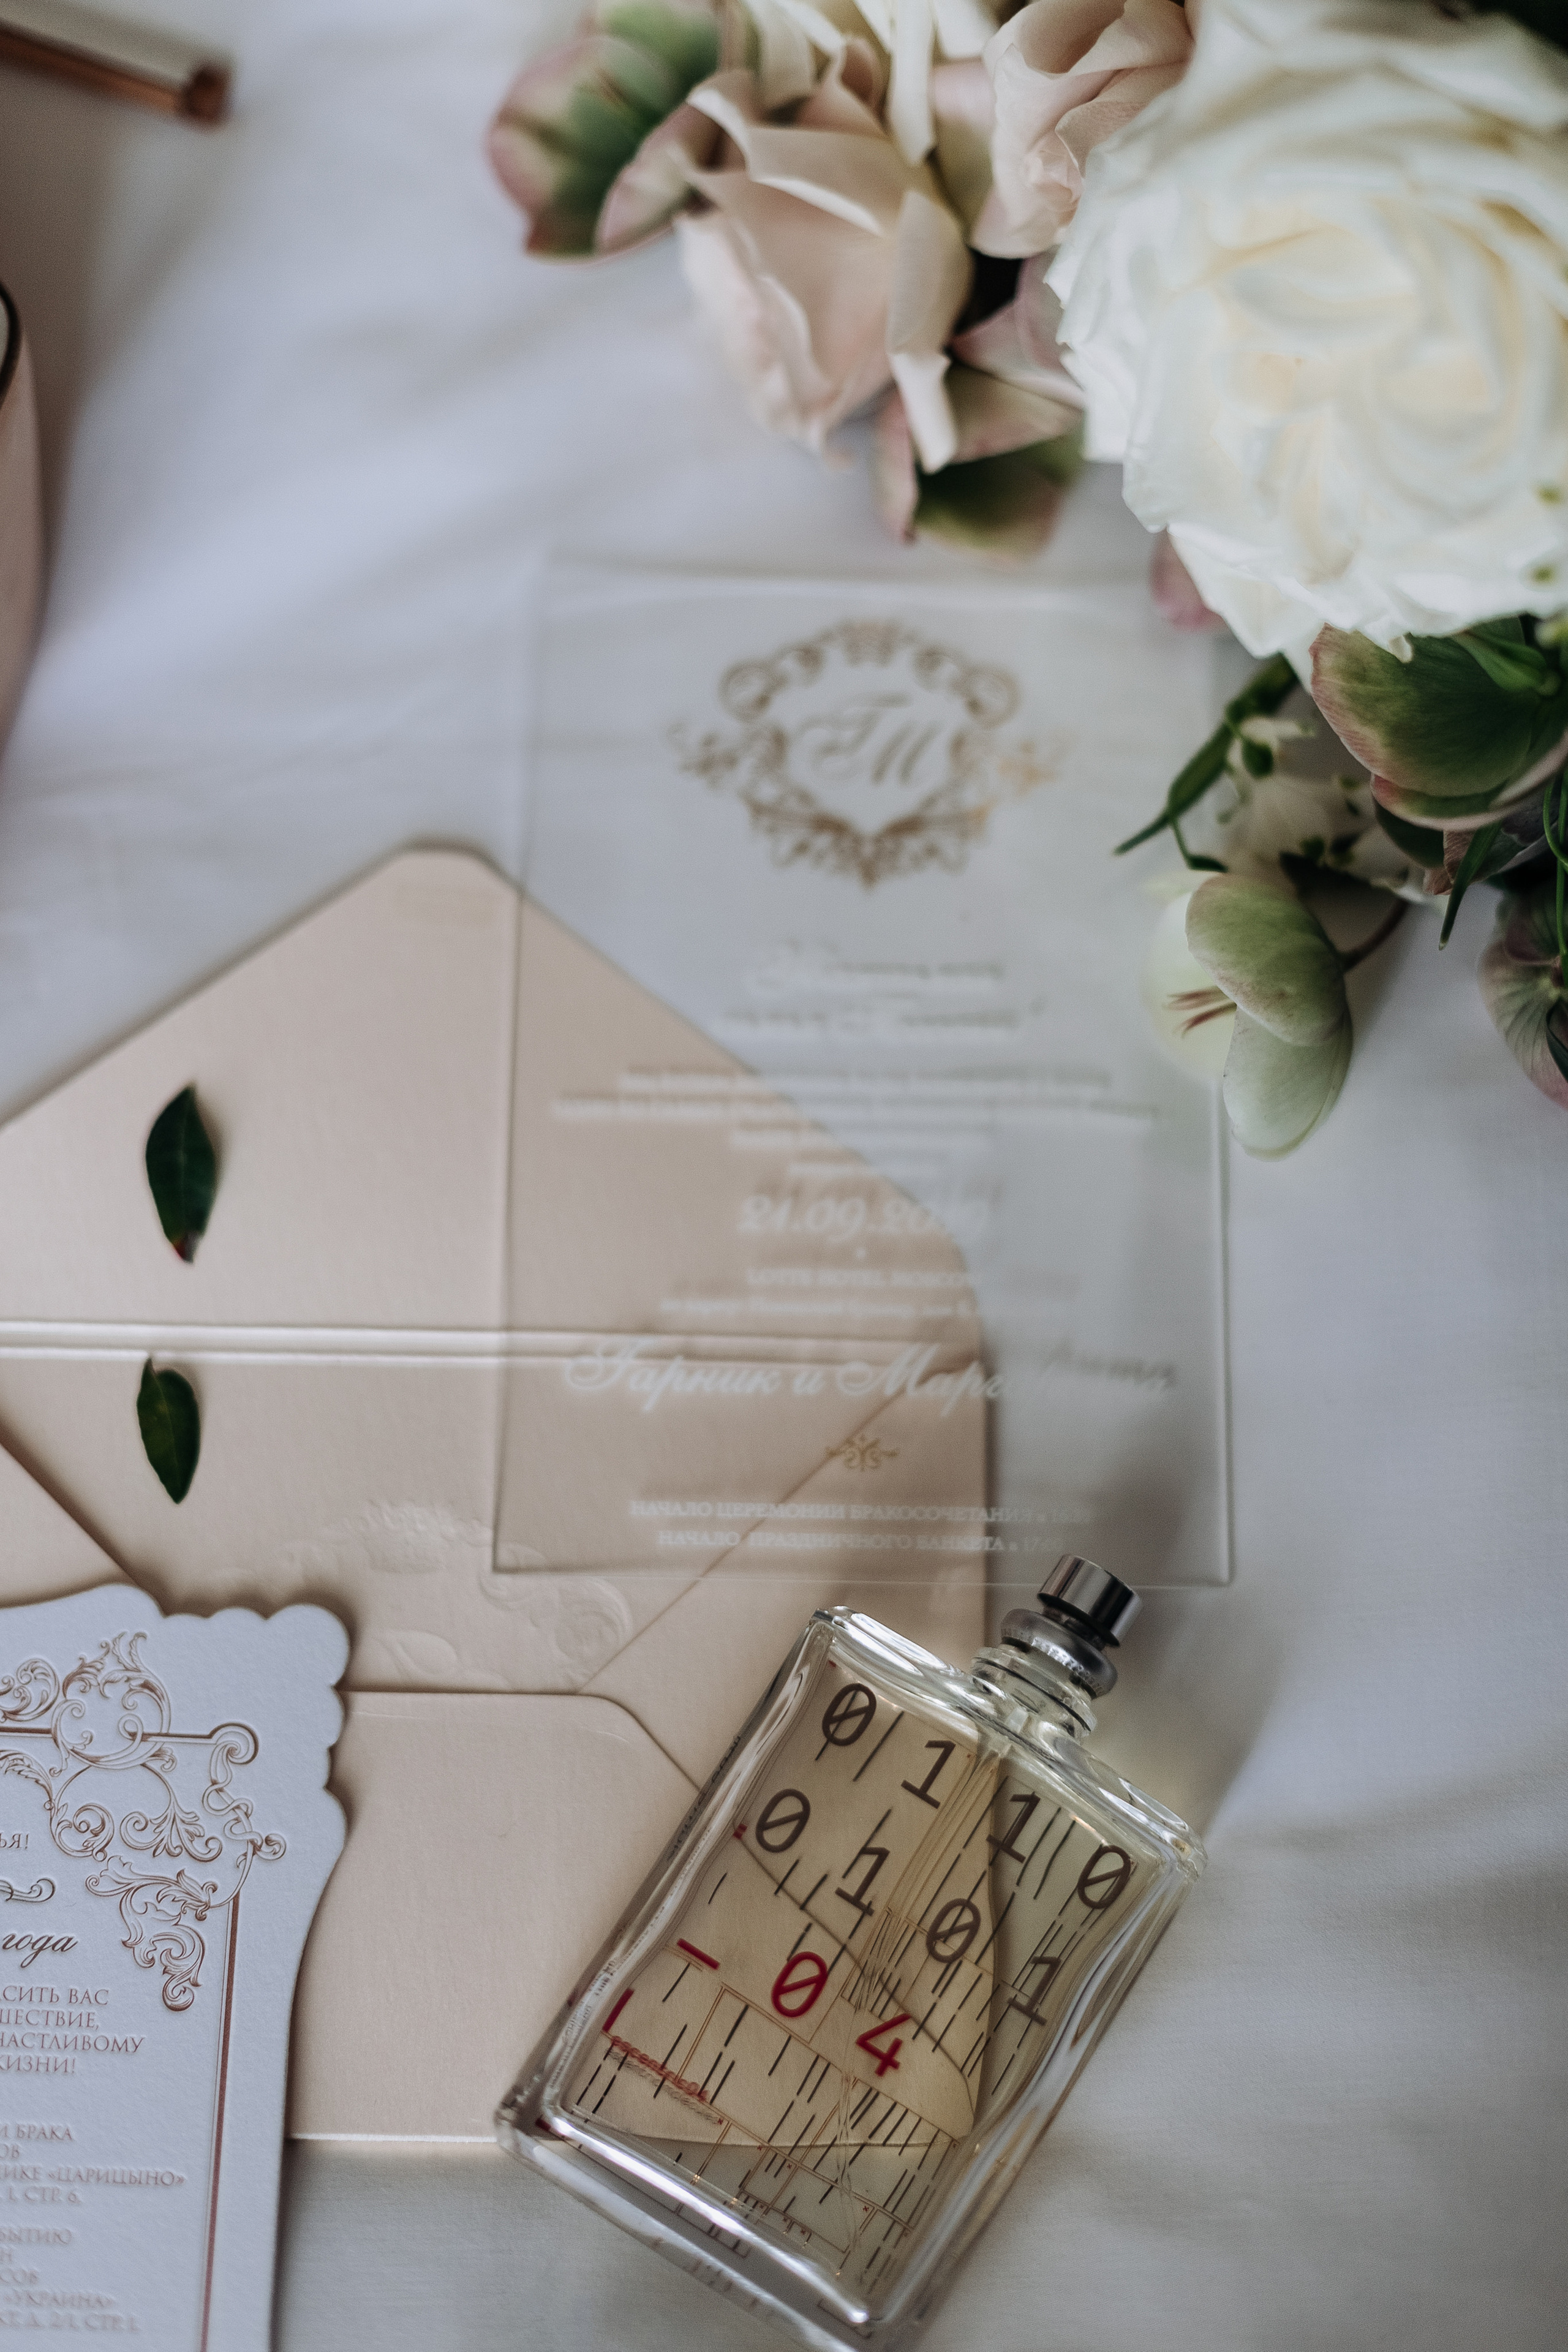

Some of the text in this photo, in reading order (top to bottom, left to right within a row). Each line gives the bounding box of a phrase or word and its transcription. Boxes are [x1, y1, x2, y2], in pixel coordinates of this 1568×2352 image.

[631, 1501, 713, 1517] НАЧАЛО
[717, 1502, 846, 1519] ЦЕРЕМОНИИ
[658, 1531, 740, 1546] НАЧАЛО
[748, 1532, 912, 1549] ПРАЗДНИЧНОГО
[2, 1934, 78, 1968] года
[0, 1985, 109, 2005] СИТЬ ВАС
[16, 2124, 74, 2141] БРАКА
[0, 2166, 185, 2186] ИКЕ «ЦАРИЦЫНО»
